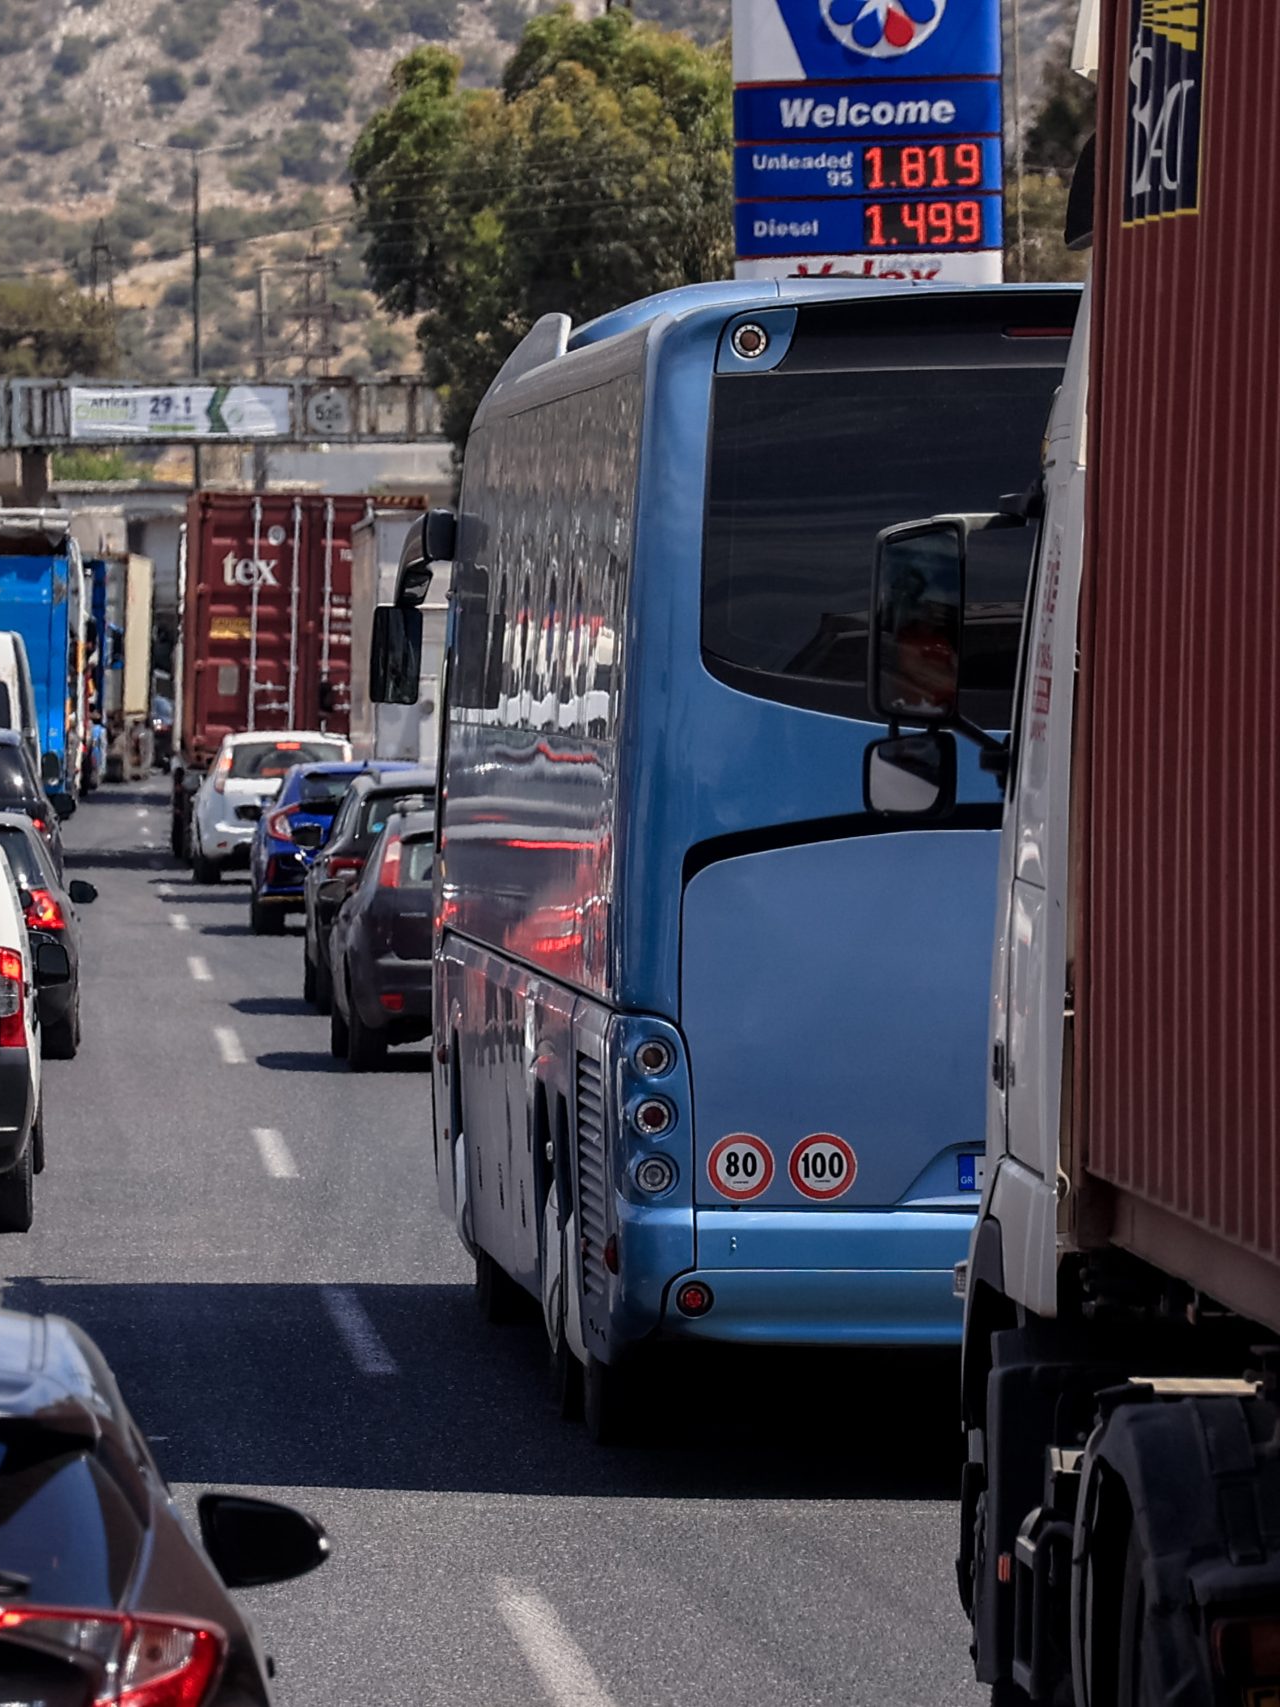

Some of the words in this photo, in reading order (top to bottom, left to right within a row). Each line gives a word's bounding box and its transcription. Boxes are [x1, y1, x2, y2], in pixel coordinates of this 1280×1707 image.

[779, 96, 956, 128] Welcome
[752, 151, 854, 170] Unleaded
[865, 143, 982, 188] 1.819
[826, 171, 854, 187] 95
[753, 219, 819, 238] Diesel
[864, 200, 982, 246] 1.499
[223, 550, 281, 587] tex
[725, 1151, 758, 1177] 80
[801, 1151, 844, 1178] 100
[960, 1175, 974, 1185] GR
